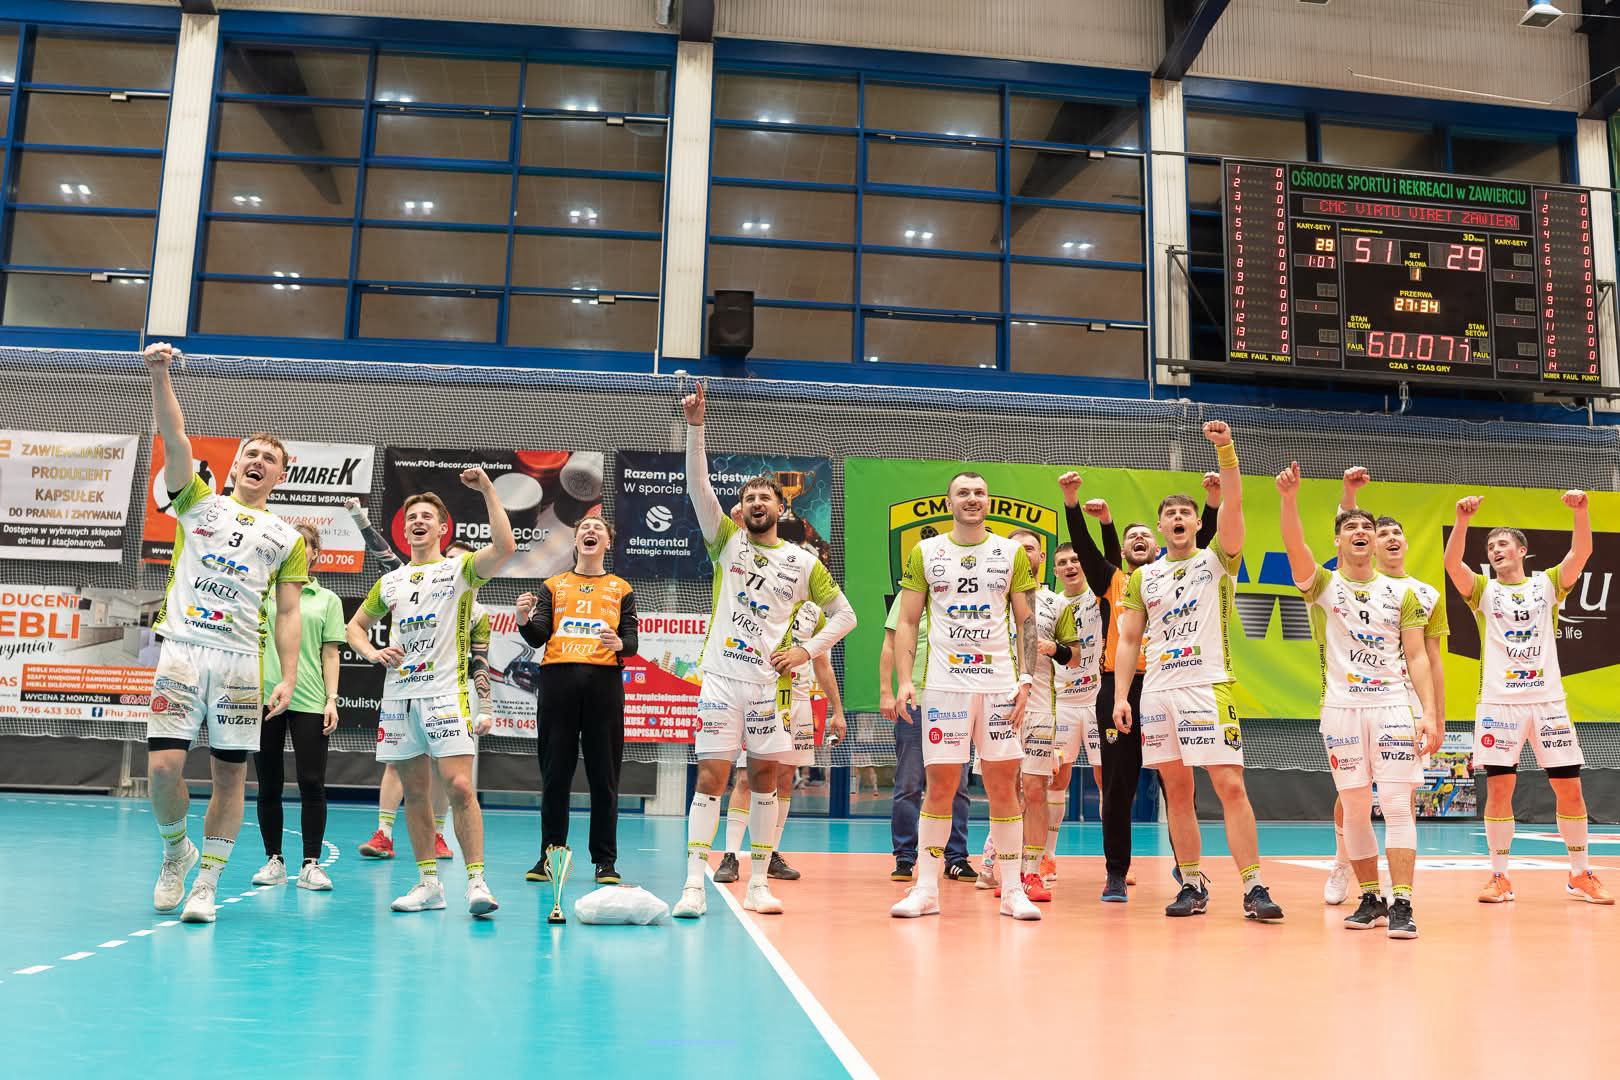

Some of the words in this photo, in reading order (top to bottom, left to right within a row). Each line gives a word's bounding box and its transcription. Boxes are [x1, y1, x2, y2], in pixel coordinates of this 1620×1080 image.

[1234, 178, 1240, 187] 2
[1292, 167, 1344, 189] OŚRODEK
[1347, 176, 1390, 192] SPORTU
[1393, 178, 1397, 193] i
[1399, 180, 1453, 198] REKREACJI
[1456, 186, 1466, 199] w
[1469, 186, 1526, 205] ZAWIERCIU
[1235, 192, 1241, 200] 3
[1236, 205, 1241, 213] 4
[1320, 200, 1347, 213] CMC
[1355, 202, 1400, 217] VIRTU
[1409, 206, 1451, 222] VIRET
[1542, 205, 1548, 213] 2
[1236, 218, 1242, 227] 5
[1296, 223, 1331, 231] KARY-SETY
[1544, 217, 1548, 226] 3
[1236, 232, 1242, 240] 6
[1316, 238, 1334, 251] 29
[1494, 239, 1528, 247] KARY-SETY
[1544, 244, 1550, 252] 5
[1238, 245, 1243, 253] 7
[1237, 258, 1243, 267] 8
[1308, 256, 1334, 268] 1:07
[1447, 245, 1483, 271] 29
[1545, 257, 1551, 265] 6
[1238, 272, 1244, 281] 9
[1547, 270, 1552, 278] 7
[1236, 286, 1244, 295] 10
[1546, 283, 1552, 291] 8
[1236, 300, 1244, 308] 11
[1394, 297, 1438, 312] 27:34
[1548, 296, 1553, 304] 9
[1236, 313, 1244, 322] 12
[1546, 309, 1554, 318] 10
[1347, 320, 1371, 329] SETÓW
[1237, 327, 1245, 336] 13
[1548, 335, 1556, 344] 12
[1237, 341, 1245, 350] 14
[1252, 353, 1268, 361] FAUL
[1548, 349, 1556, 357] 13
[394, 460, 512, 470] www.FOB-decor.com/kariera
[31, 466, 112, 481] PRODUCENT
[624, 468, 666, 479] Razem
[668, 472, 685, 482] po
[624, 483, 636, 492] W
[639, 483, 683, 496] sporcie
[35, 488, 104, 503] KAPSUŁEK
[9, 507, 23, 518] DO
[26, 508, 62, 518] PRANIA
[71, 510, 122, 520] ZMYWANIA
[913, 498, 948, 517] CM
[990, 500, 1042, 523] IRTU
[3, 524, 38, 535] Dostępne
[49, 526, 89, 537] wybranych
[91, 528, 122, 538] sklepach
[456, 523, 491, 539] FOB
[512, 528, 550, 541] ecor
[18, 537, 45, 546] on-line
[52, 538, 106, 548] stacjonarnych.
[228, 532, 244, 548] 3
[629, 536, 688, 547] elemental
[626, 548, 662, 557] strategic
[336, 555, 354, 565] 706
[202, 554, 249, 582] CMC
[745, 572, 766, 591] 77
[957, 578, 979, 594] 25
[194, 576, 239, 601] VIRTU
[410, 591, 420, 605] 4
[576, 600, 592, 614] 21
[947, 604, 990, 620] CMC
[1162, 599, 1198, 625] CMC
[1514, 610, 1530, 622] 13
[400, 613, 438, 634] CMC
[563, 621, 602, 634] CMC
[949, 625, 990, 643] VIRTU
[1565, 626, 1583, 639] life
[561, 642, 598, 656] VIRTU
[1506, 646, 1541, 659] VIRTU
[723, 649, 764, 666] zawiercie
[1161, 658, 1202, 671] zawiercie
[950, 666, 994, 675] zawiercie
[1506, 680, 1544, 688] zawiercie
[66, 694, 110, 703] MONTAŻEM
[336, 696, 381, 711] Okulisty
[22, 706, 39, 715] 796
[44, 707, 62, 715] 433
[64, 707, 82, 715] 303
[1228, 705, 1236, 720] 6
[496, 718, 513, 728] 515
[517, 719, 536, 730] 043
